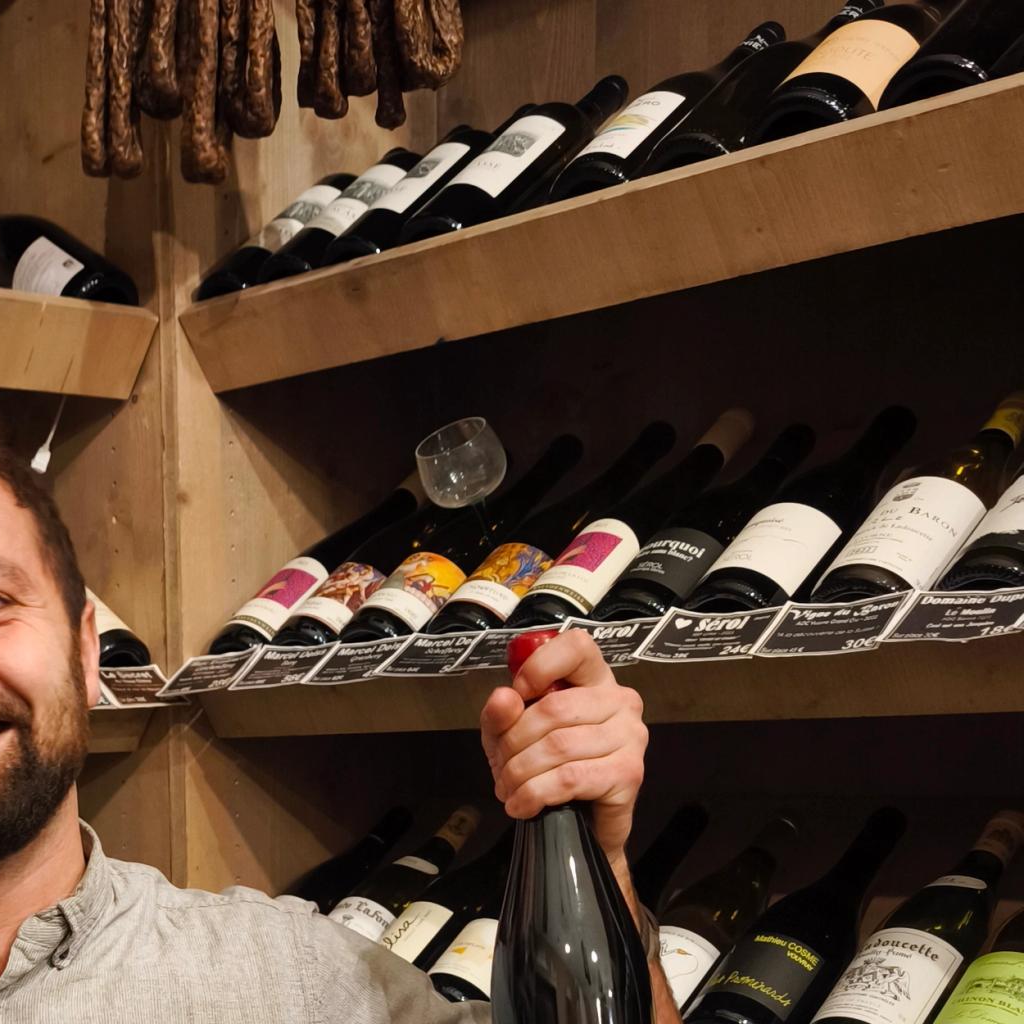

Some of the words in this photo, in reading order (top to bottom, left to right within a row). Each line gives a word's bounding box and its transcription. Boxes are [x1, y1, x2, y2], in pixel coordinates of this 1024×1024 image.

[920, 596, 987, 606] Domaine
[694, 615, 749, 633] Sérol
[788, 942, 821, 967] COSME
